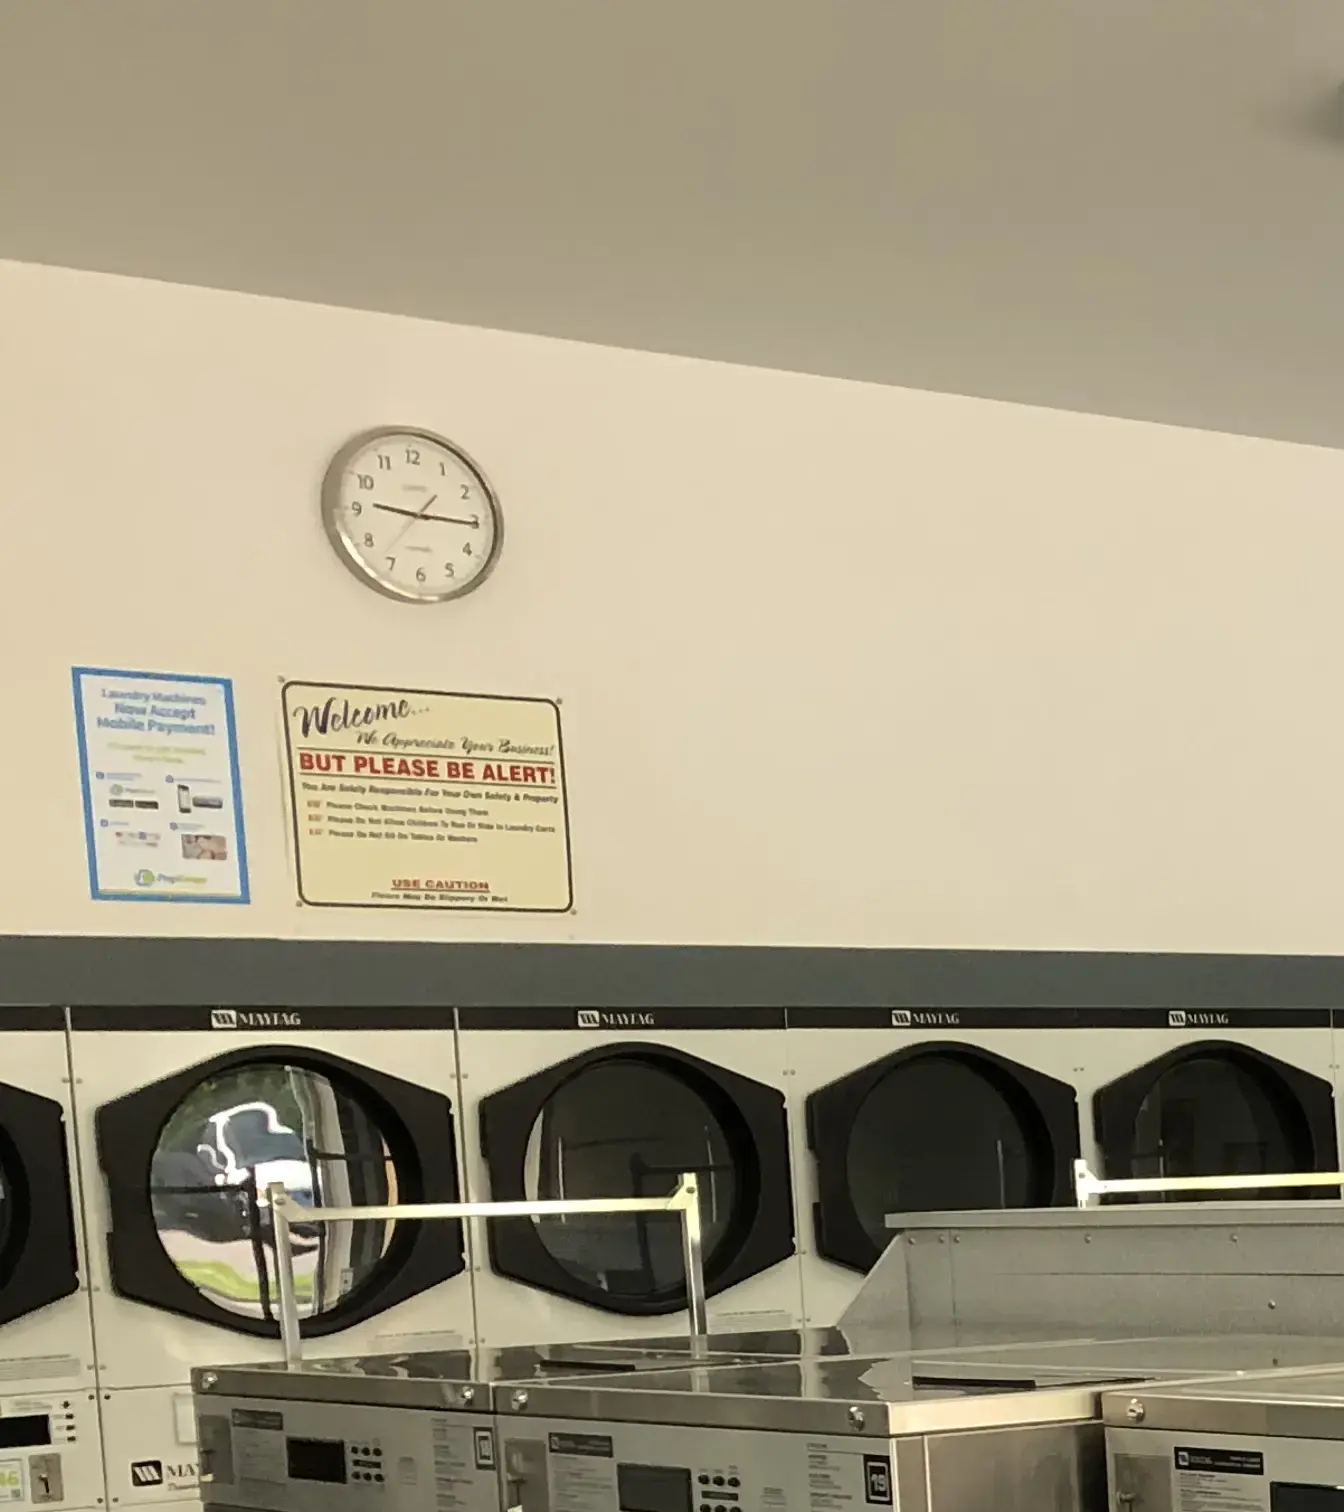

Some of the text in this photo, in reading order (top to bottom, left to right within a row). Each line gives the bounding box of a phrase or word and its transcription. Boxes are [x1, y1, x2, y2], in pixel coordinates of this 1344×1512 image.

[377, 455, 391, 470] 11
[405, 450, 420, 465] 12
[440, 462, 445, 476] 1
[358, 475, 374, 490] 10
[460, 485, 470, 499] 2
[352, 502, 362, 516] 9
[364, 533, 374, 547] 8
[463, 543, 472, 556] 4
[385, 557, 396, 570] 7
[445, 563, 454, 577] 5
[416, 568, 426, 581] 6
[300, 753, 555, 783] BUT PLEASE BE ALERT!
[392, 879, 488, 889] USE CAUTION
[239, 1013, 301, 1025] MAYTAG
[602, 1013, 654, 1024] MAYTAG
[913, 1013, 959, 1024] MAYTAG
[1187, 1014, 1229, 1024] MAYTAG
